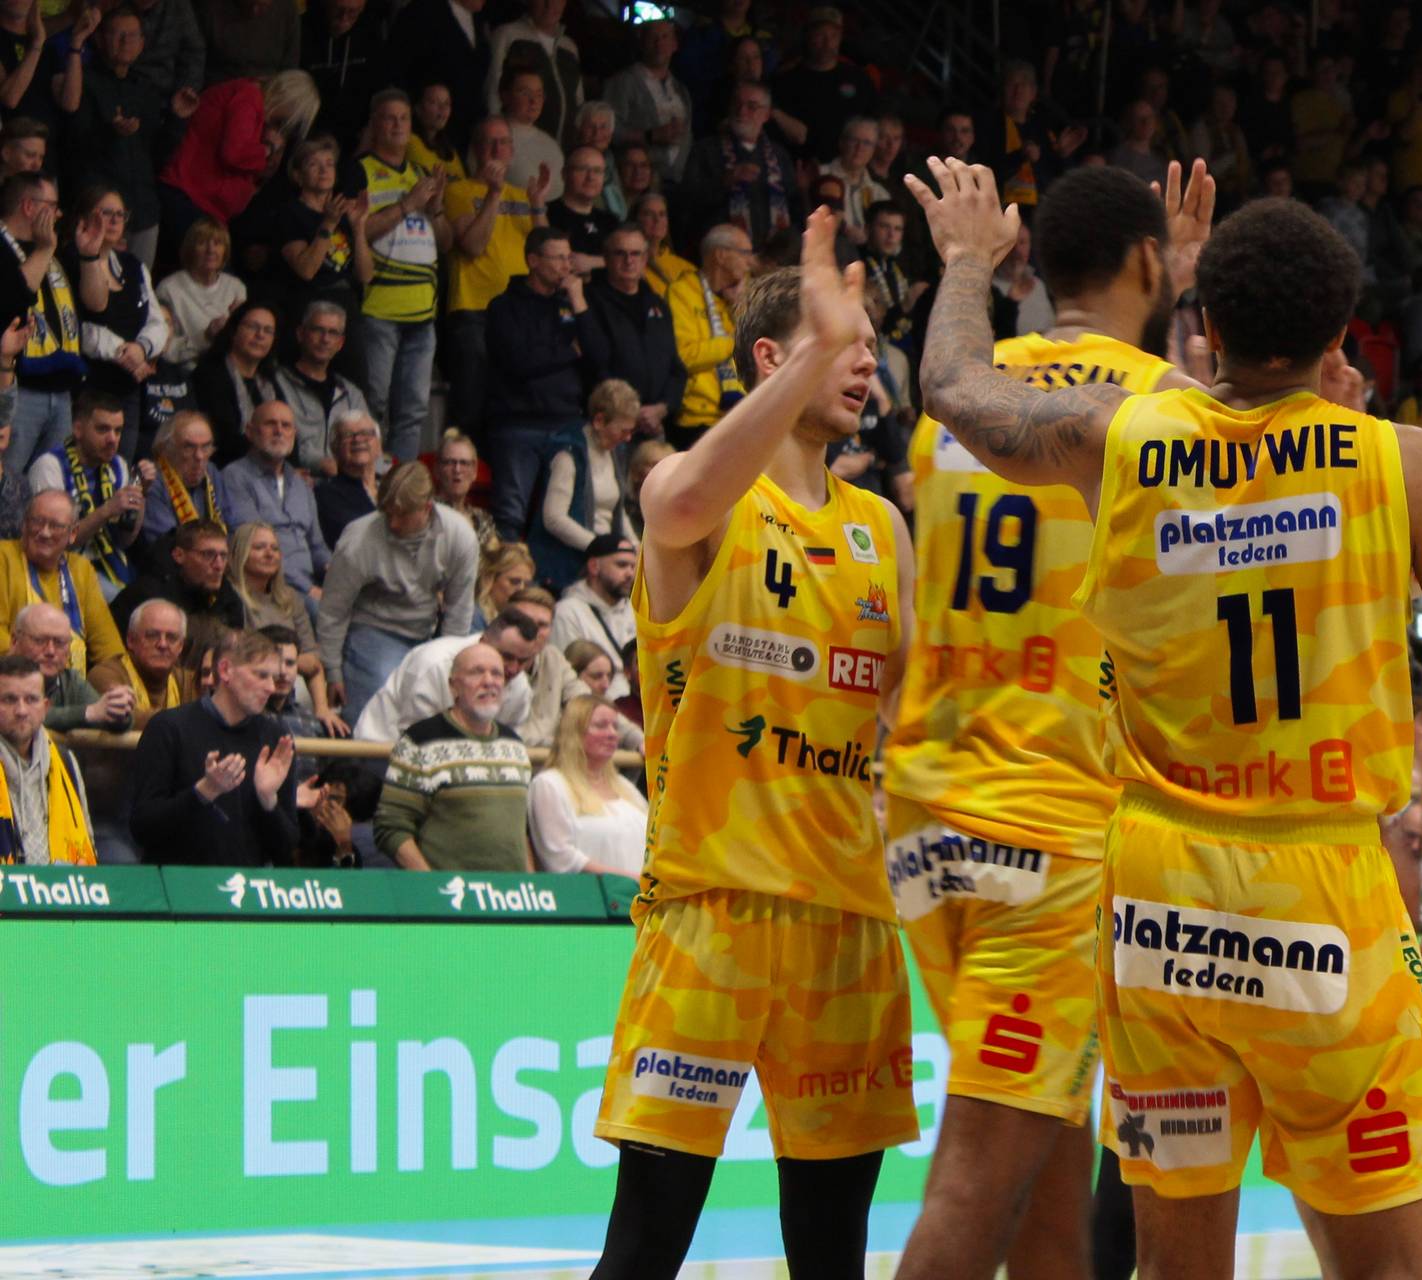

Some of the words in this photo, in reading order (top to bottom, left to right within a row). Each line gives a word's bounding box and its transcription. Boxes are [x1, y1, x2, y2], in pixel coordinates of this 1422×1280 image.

[1160, 503, 1337, 553] platzmann
[950, 492, 1041, 614] 19
[1218, 542, 1288, 566] federn
[765, 548, 797, 609] 4
[832, 653, 886, 690] REW
[1217, 587, 1302, 725] 11
[1167, 751, 1294, 798] mark
[9, 873, 110, 907] Thalia
[250, 880, 343, 911] Thalia
[468, 882, 557, 913] Thalia
[1163, 958, 1265, 998] federn
[669, 1082, 718, 1104] federn
[799, 1062, 882, 1099] mark
[19, 1040, 188, 1187] er
